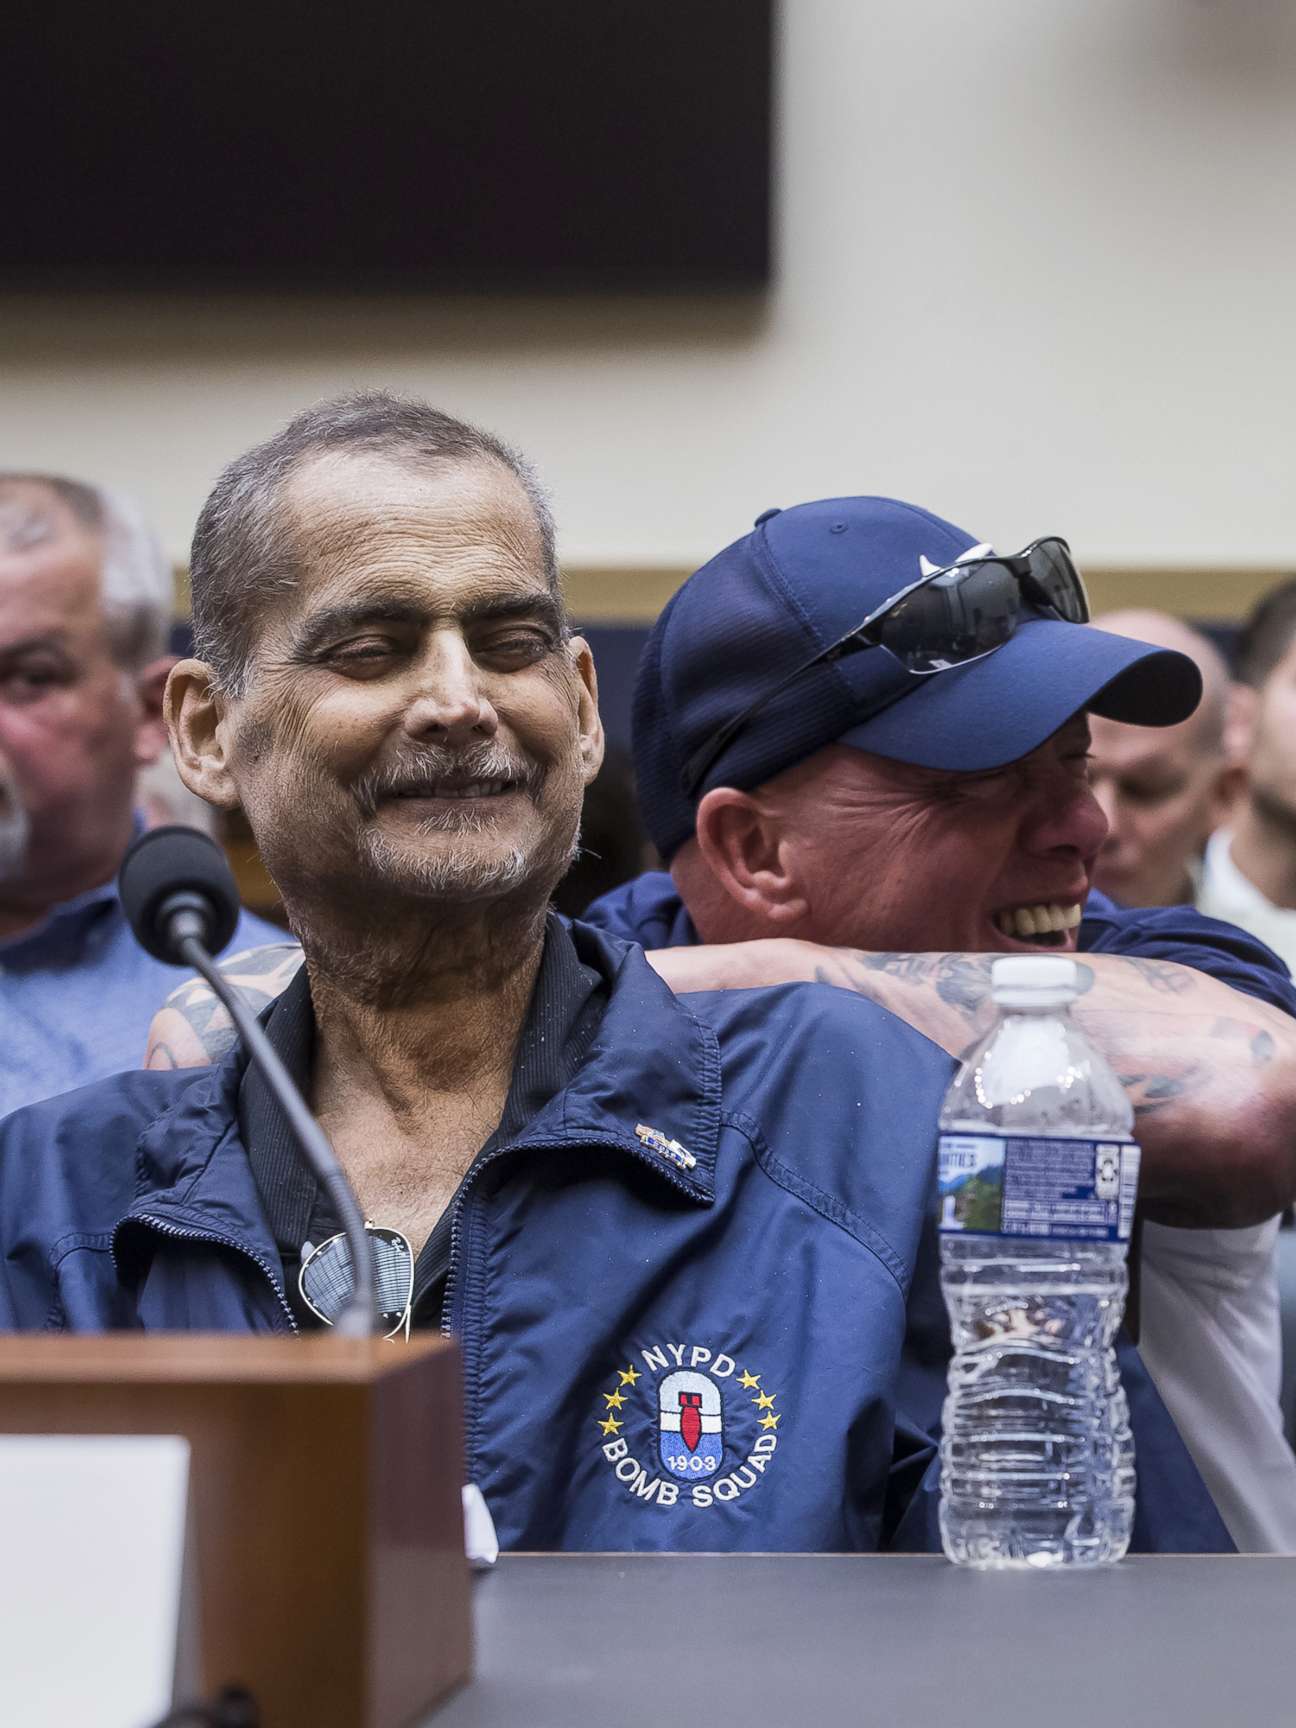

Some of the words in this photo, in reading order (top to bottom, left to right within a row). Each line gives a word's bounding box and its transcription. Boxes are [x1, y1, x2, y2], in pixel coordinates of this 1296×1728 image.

[641, 1343, 736, 1378] NYPD
[602, 1438, 680, 1506] BOMB
[692, 1434, 778, 1508] SQUAD
[667, 1455, 717, 1472] 1903
